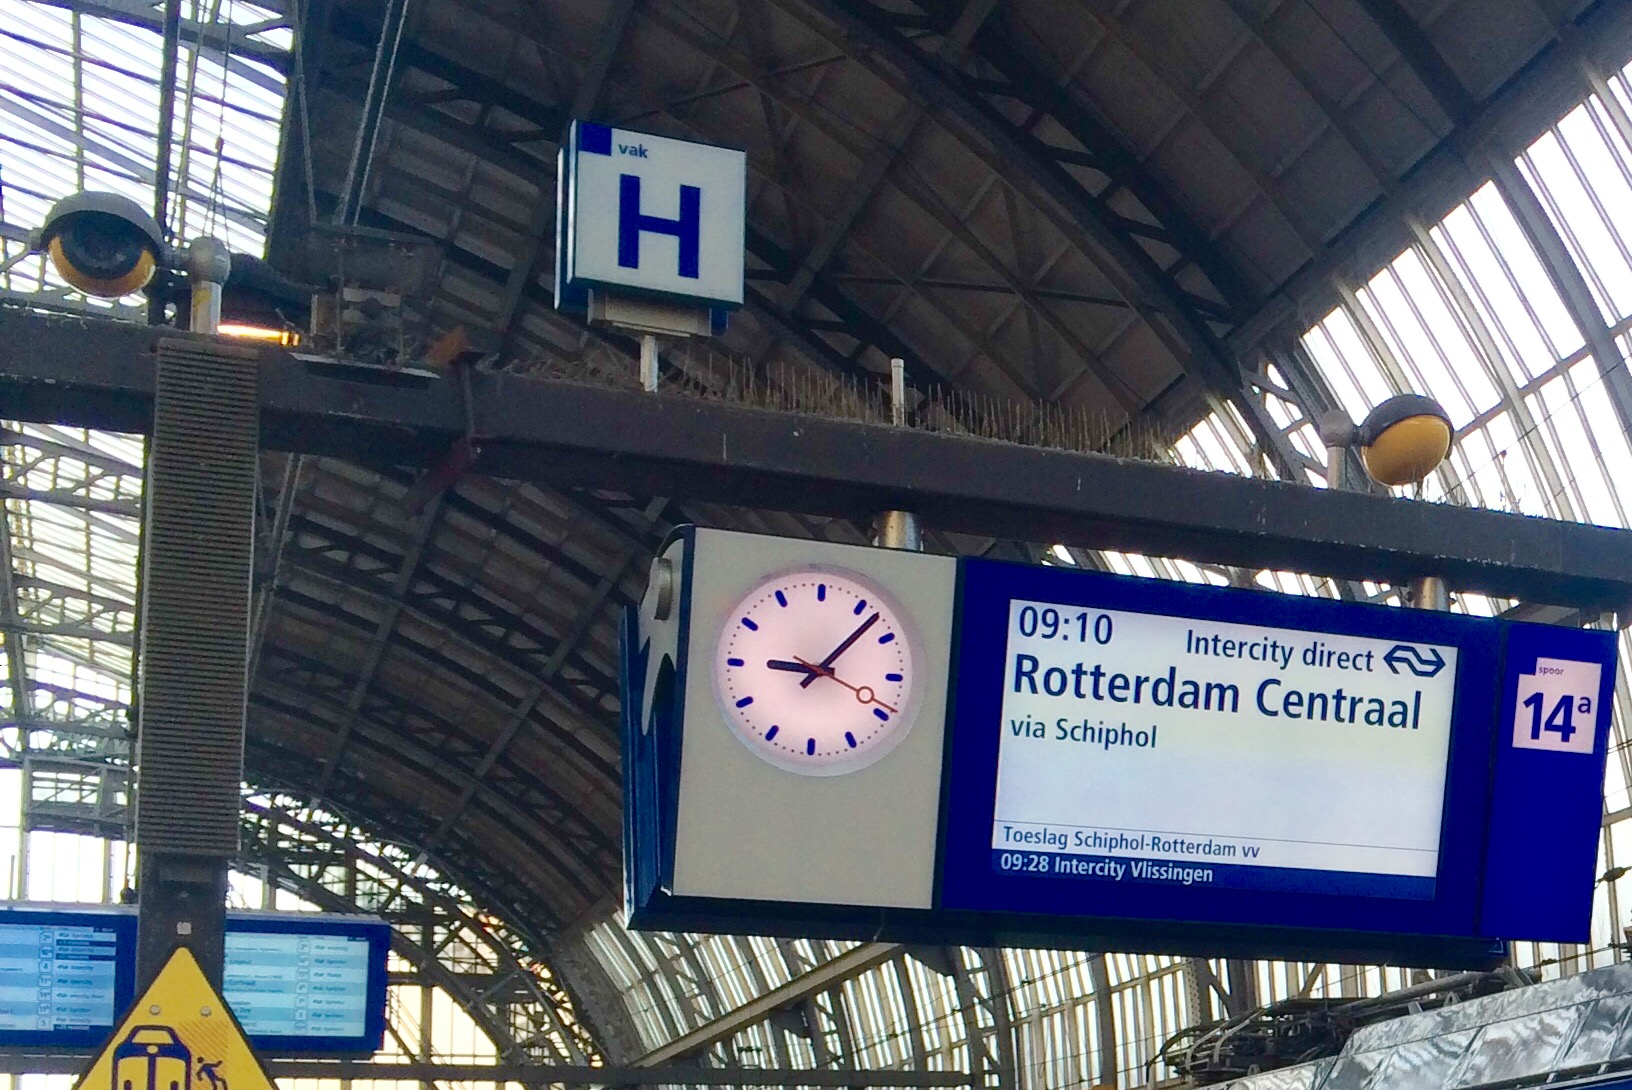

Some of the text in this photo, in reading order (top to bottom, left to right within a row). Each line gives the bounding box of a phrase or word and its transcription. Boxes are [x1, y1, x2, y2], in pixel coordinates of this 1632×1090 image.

[618, 143, 649, 159] vak
[617, 173, 701, 280] H
[1019, 605, 1114, 645] 09:10
[1186, 629, 1375, 672] Intercity direct
[1538, 665, 1564, 676] spoor
[1013, 653, 1422, 730] Rotterdam Centraal
[1010, 714, 1157, 750] via Schiphol
[1003, 825, 1260, 858] Toeslag Schiphol-Rotterdam vv
[1001, 853, 1213, 885] 09:28 Intercity Vlissingen
